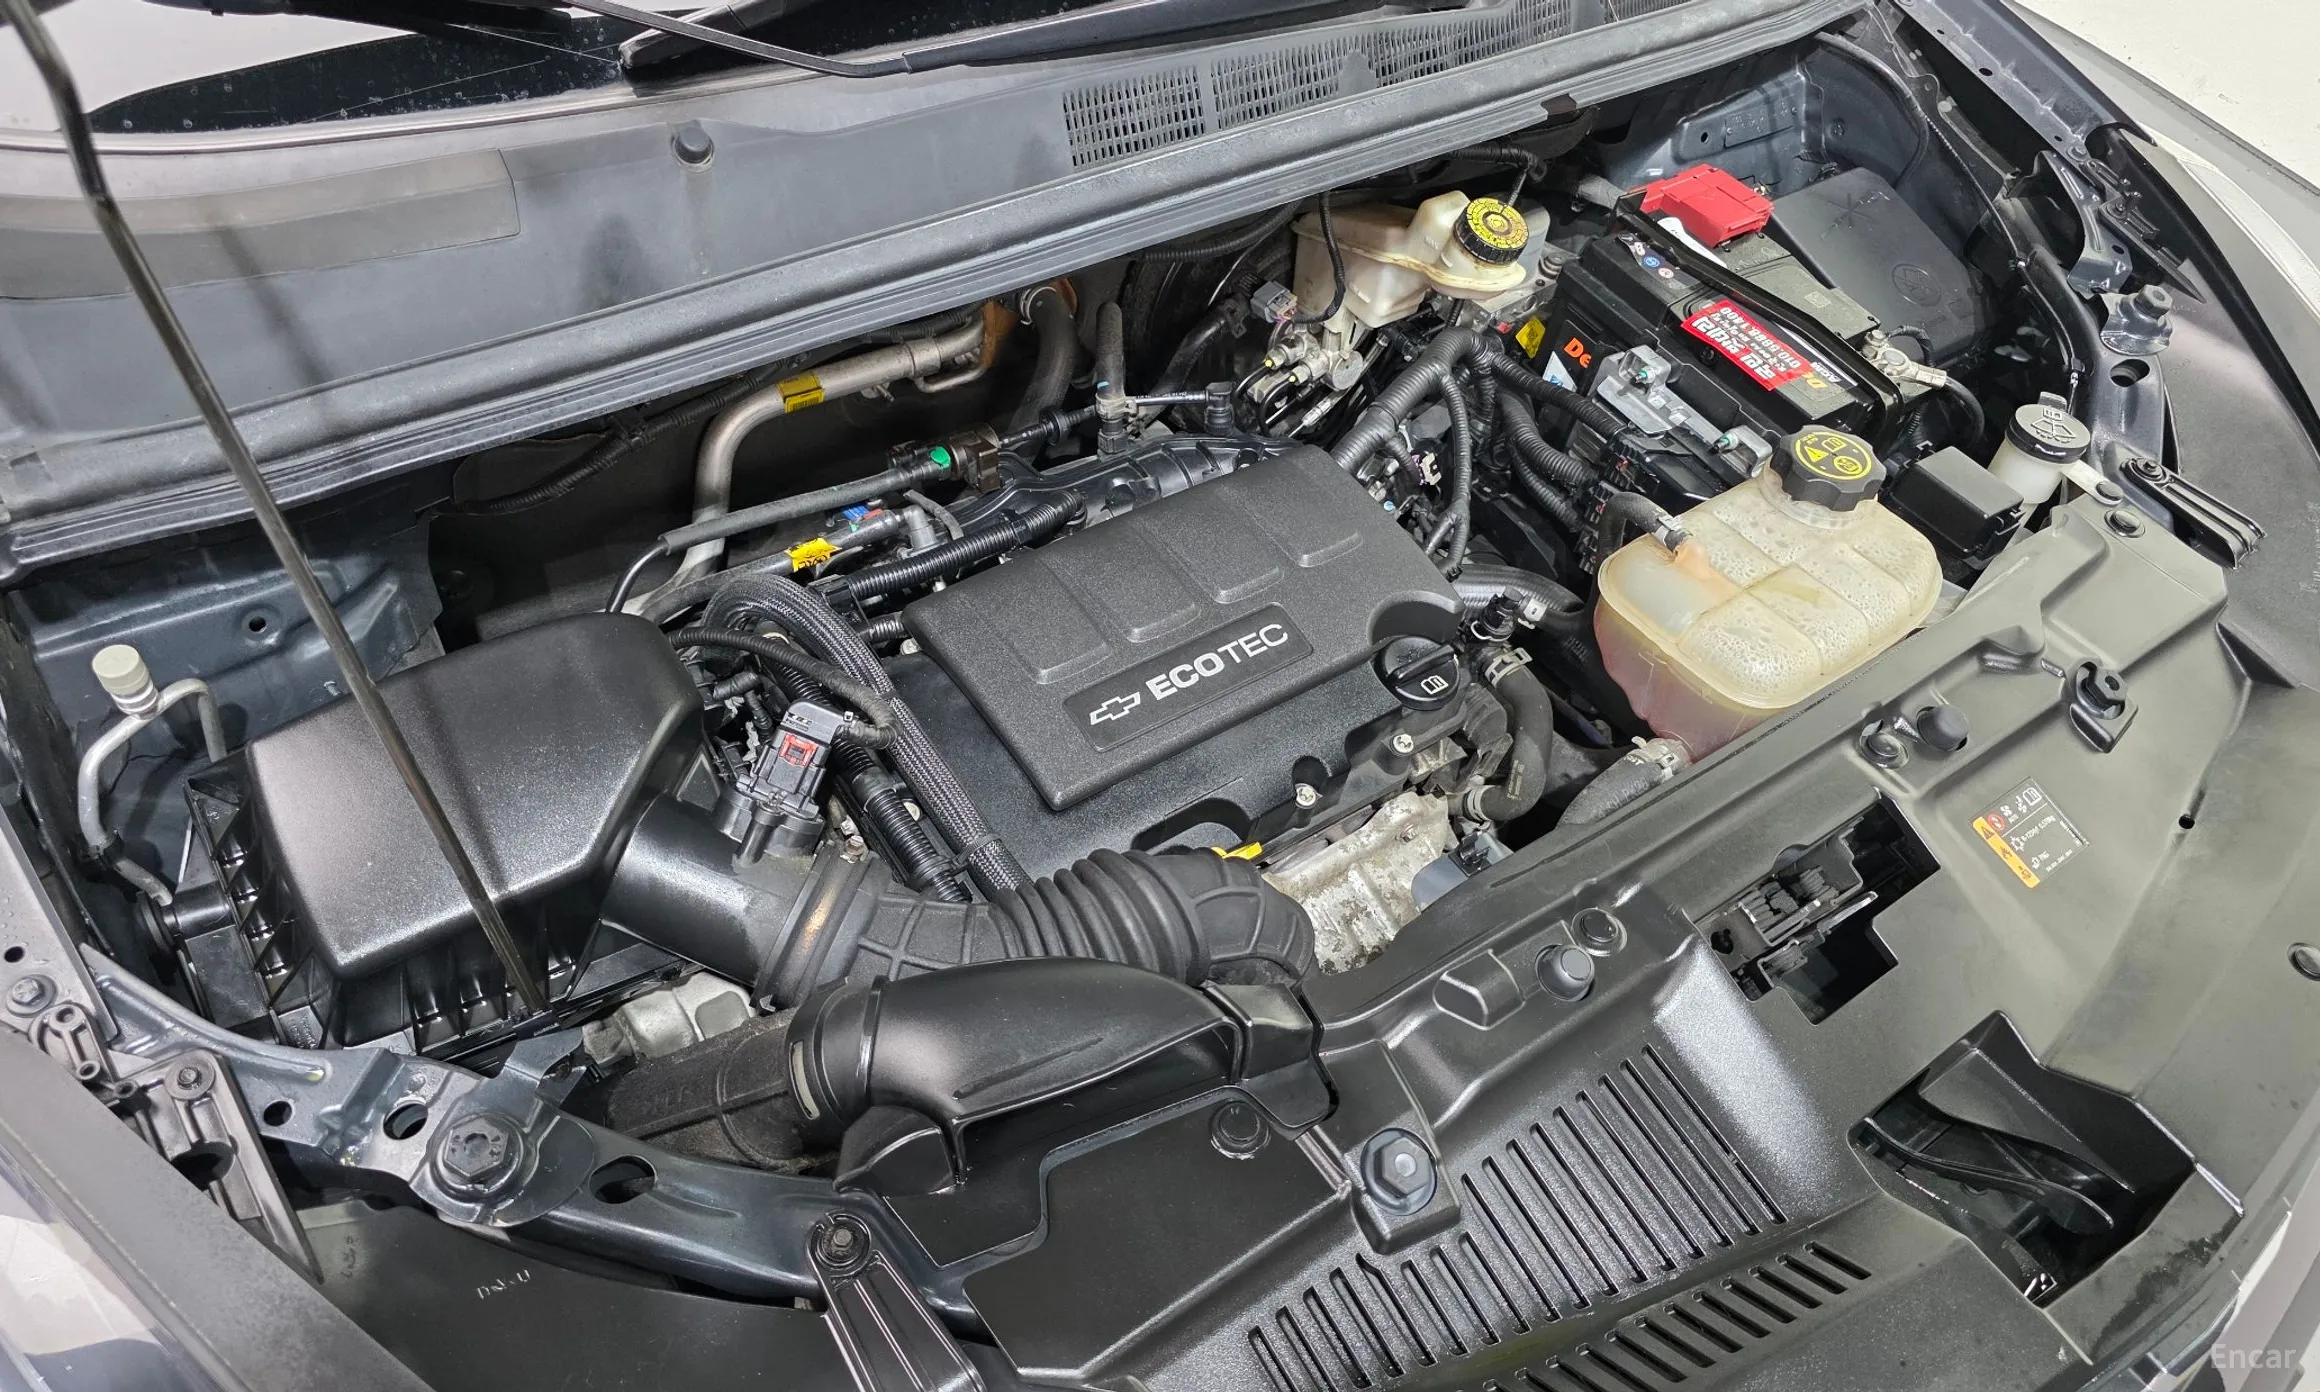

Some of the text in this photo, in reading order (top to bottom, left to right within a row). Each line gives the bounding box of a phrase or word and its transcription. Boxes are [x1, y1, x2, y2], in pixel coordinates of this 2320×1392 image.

[1739, 353, 1776, 380] 국민
[1809, 361, 1842, 383] AGM
[1145, 623, 1289, 701] ECOTEC
